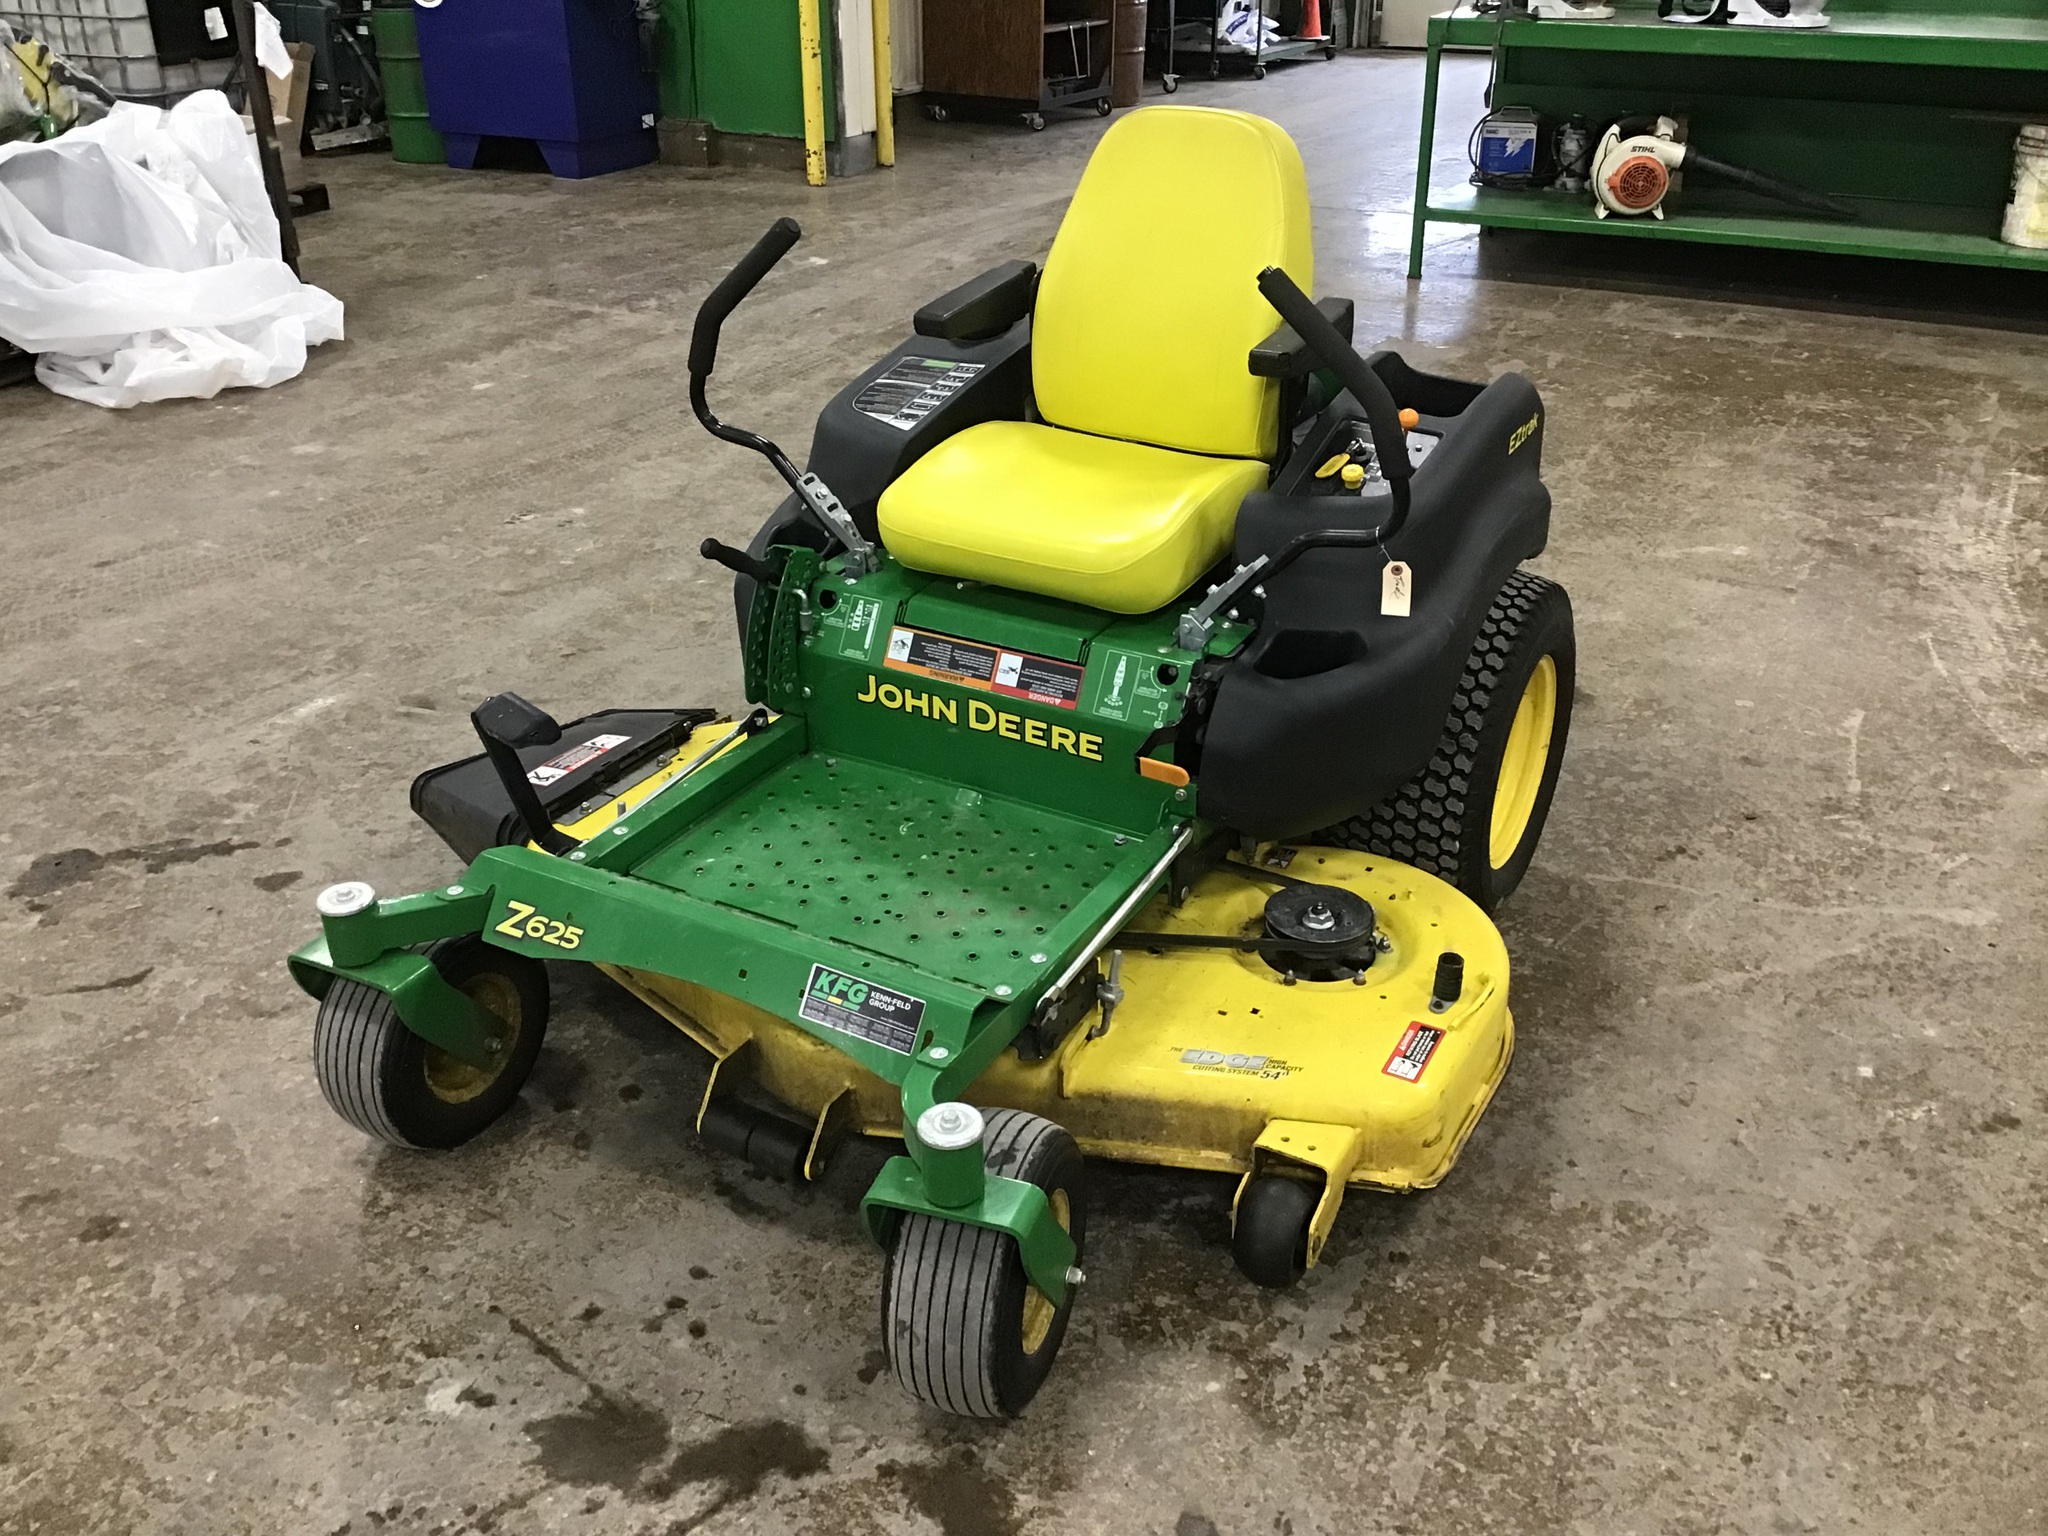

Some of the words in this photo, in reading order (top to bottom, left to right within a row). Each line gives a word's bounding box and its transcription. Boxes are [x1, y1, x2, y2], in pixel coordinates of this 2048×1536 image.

[928, 669, 961, 682] WARNING
[1028, 691, 1055, 705] DANGER
[857, 674, 958, 725] JOHN
[967, 698, 1104, 762] DEERE
[495, 900, 584, 950] Z625
[813, 970, 869, 1004] KFG
[868, 998, 896, 1013] GROUP
[870, 990, 911, 1011] KENN-FELD
[1179, 1049, 1268, 1071] EDGE
[1265, 1063, 1304, 1073] CAPACITY
[1192, 1064, 1226, 1073] CUTTING
[1226, 1068, 1260, 1077] SYSTEM
